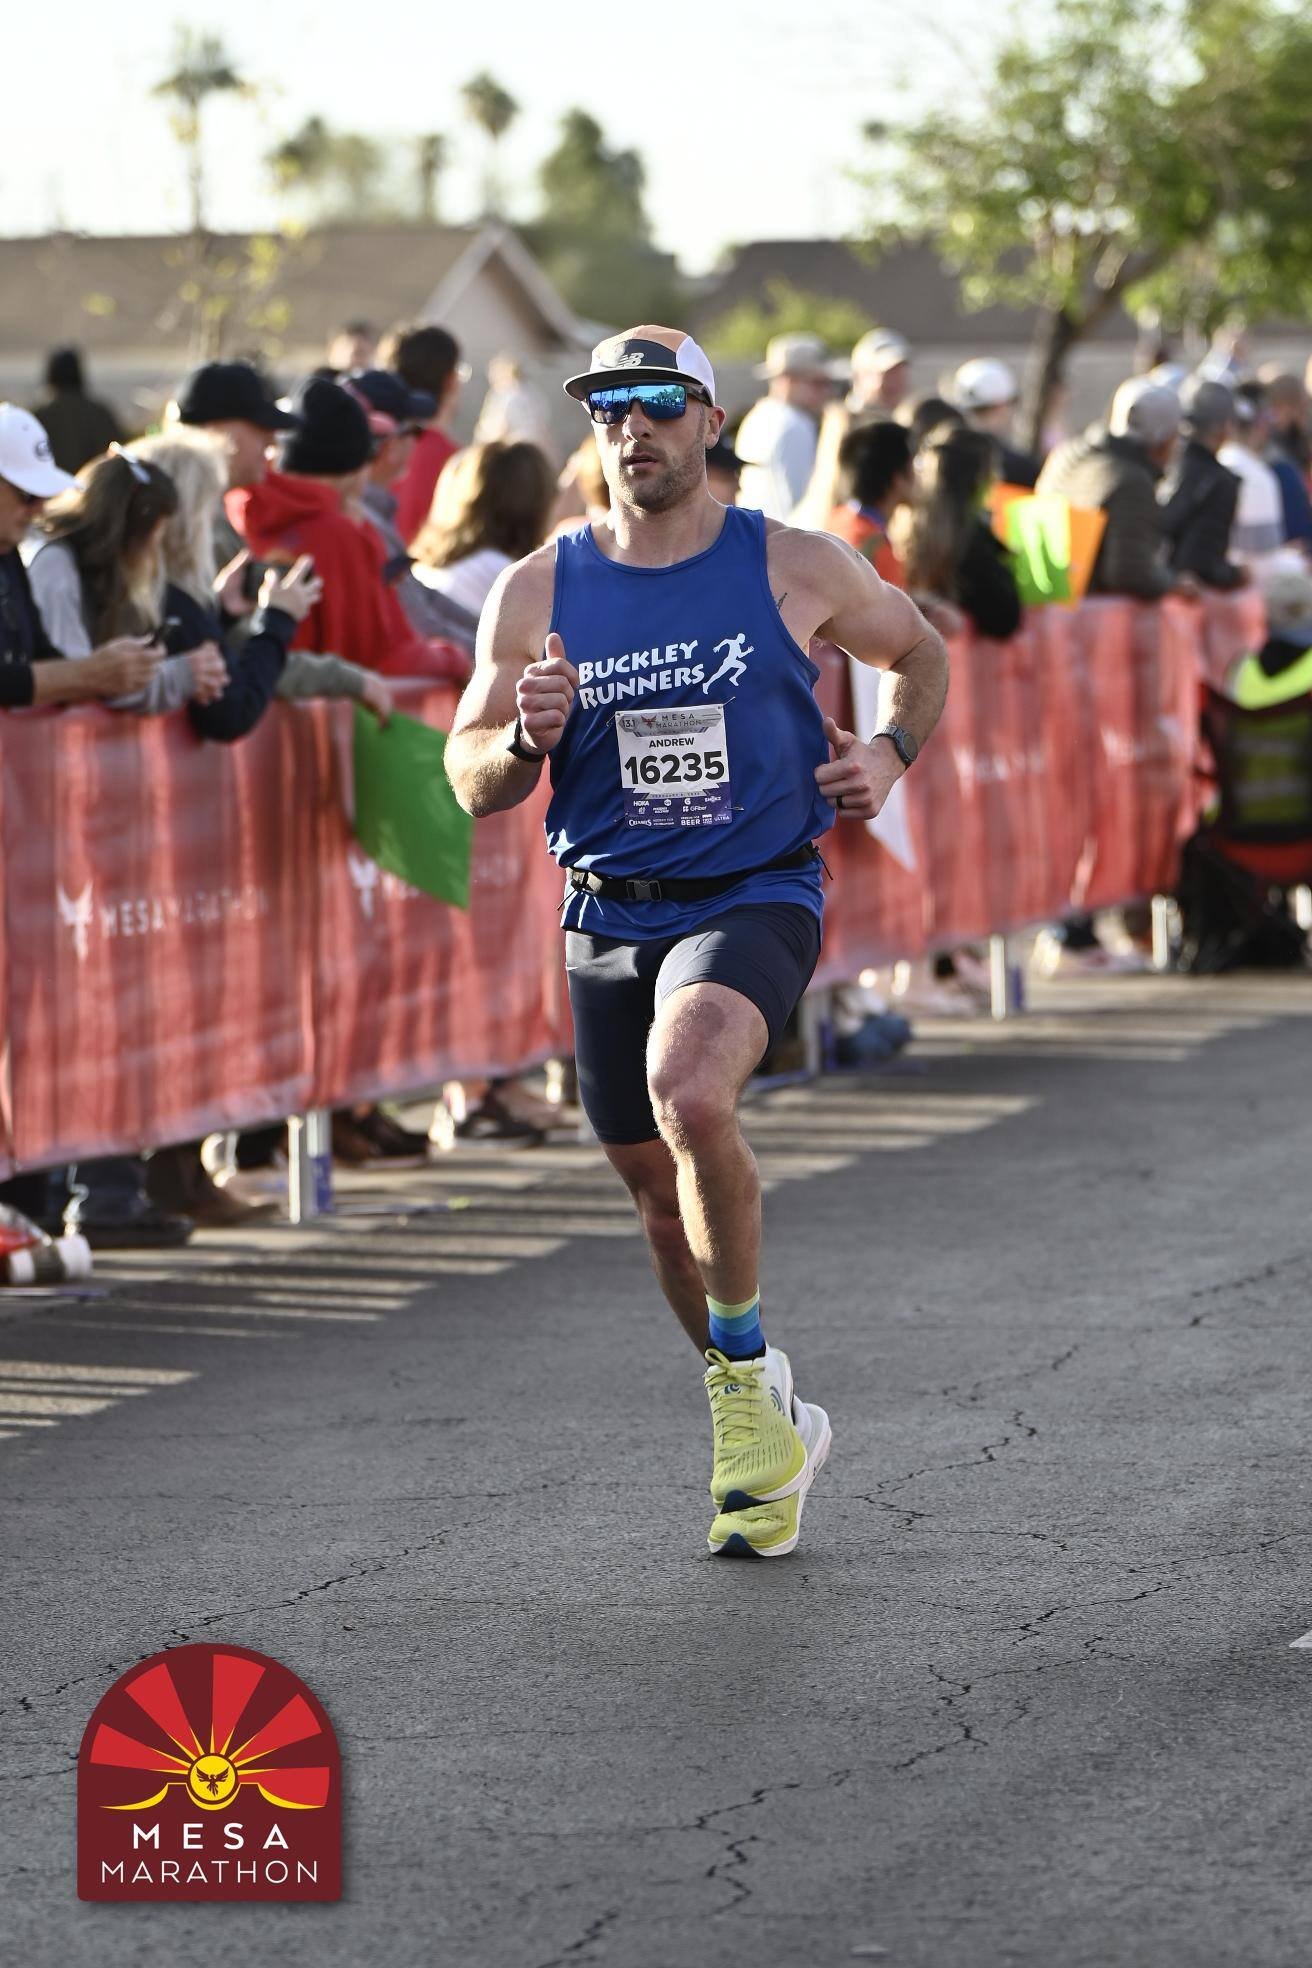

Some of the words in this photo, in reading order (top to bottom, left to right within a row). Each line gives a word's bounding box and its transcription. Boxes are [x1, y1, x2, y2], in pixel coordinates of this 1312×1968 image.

[578, 640, 698, 685] BUCKLEY
[579, 664, 705, 710] RUNNERS
[656, 719, 702, 728] MARATHON
[661, 713, 695, 721] MESA
[649, 737, 695, 748] ANDREW
[624, 751, 725, 785] 16235
